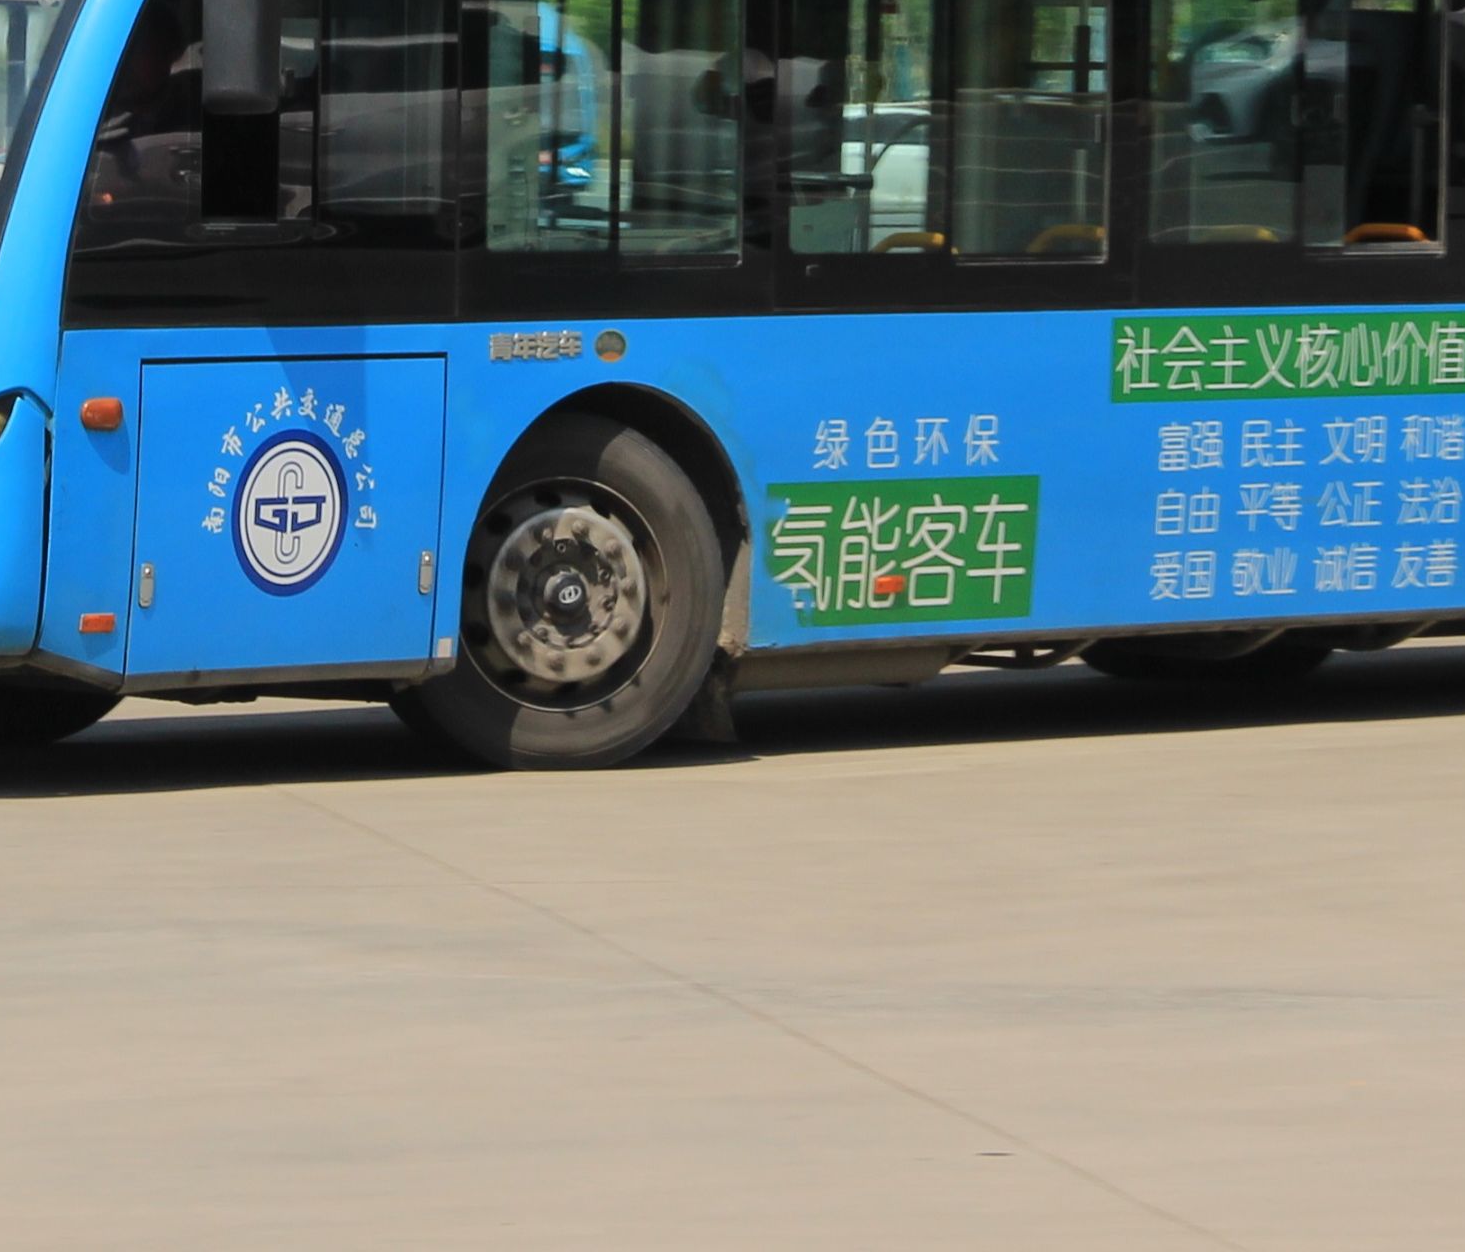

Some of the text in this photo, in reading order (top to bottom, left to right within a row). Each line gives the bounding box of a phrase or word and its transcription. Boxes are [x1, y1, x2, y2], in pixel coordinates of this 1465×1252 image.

[489, 330, 582, 361] 青年汽车
[812, 414, 1000, 469] 绿色环保
[1158, 420, 1224, 471] 富强
[1240, 418, 1306, 467] 民主
[1319, 415, 1387, 464] 文明
[1155, 476, 1463, 536] 自由 平等 公正 法治
[1149, 539, 1458, 601] 爱国 敬业 诚信 友善
